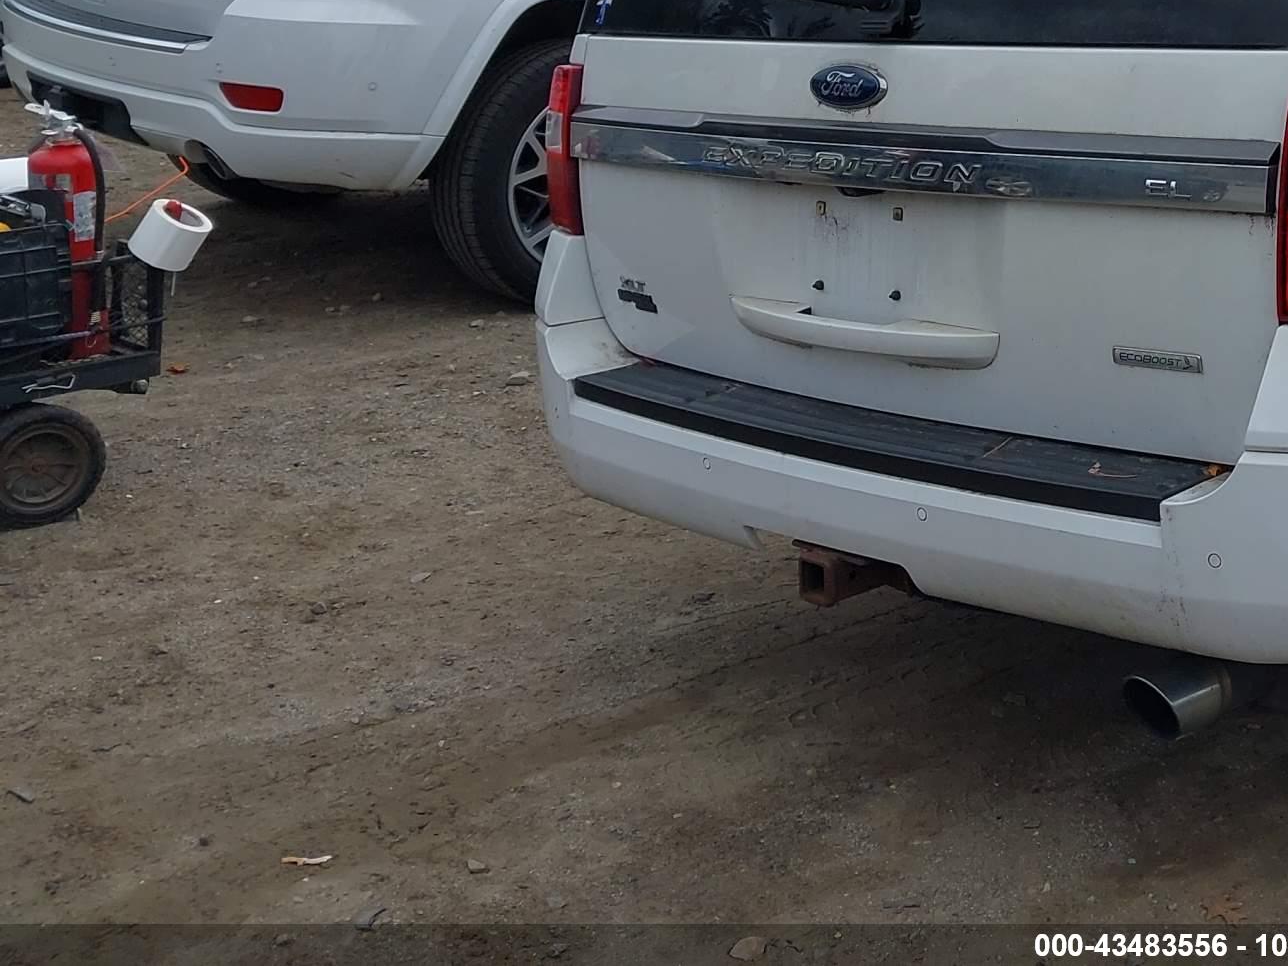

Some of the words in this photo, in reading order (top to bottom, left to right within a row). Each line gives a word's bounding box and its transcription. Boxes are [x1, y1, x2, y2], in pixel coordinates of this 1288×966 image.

[820, 70, 868, 97] Ford
[703, 143, 981, 184] EXPEDITION
[1145, 179, 1192, 200] EL
[1119, 352, 1183, 367] ECOBOOST
